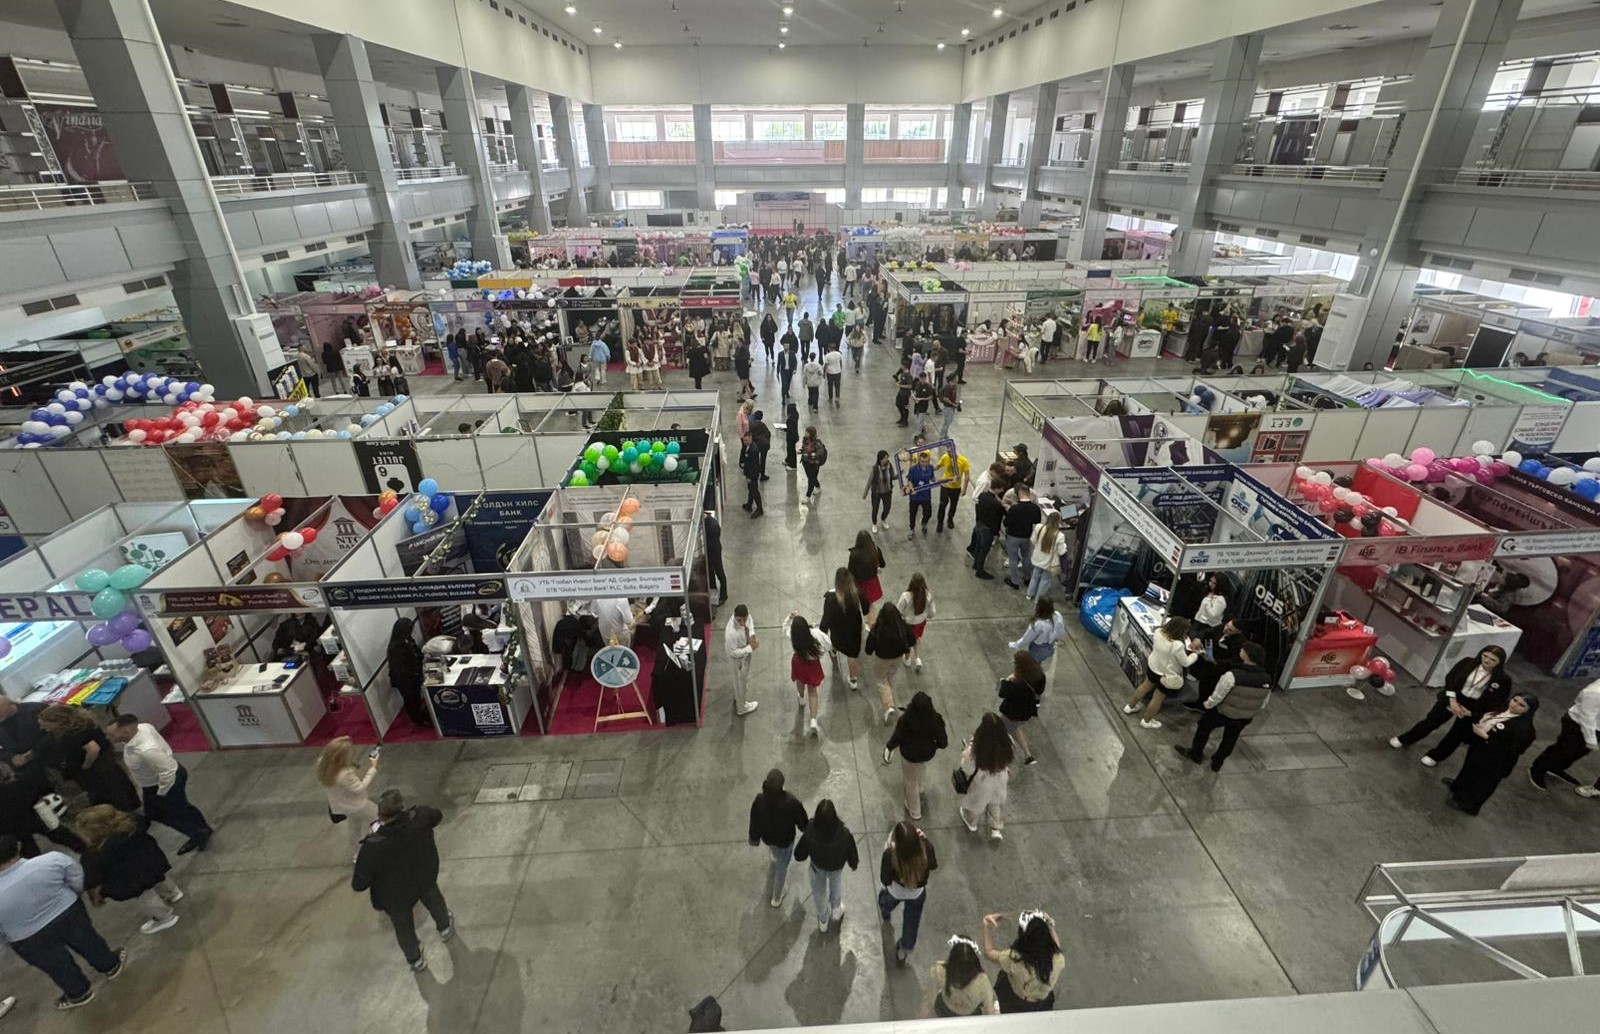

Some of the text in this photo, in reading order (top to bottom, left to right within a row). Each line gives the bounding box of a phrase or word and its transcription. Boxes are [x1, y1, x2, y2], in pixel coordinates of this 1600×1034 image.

[620, 435, 688, 443] SUSTAINABLE
[372, 456, 404, 465] JULIET
[1410, 544, 1451, 554] Finance
[1457, 542, 1483, 552] Bank
[1255, 584, 1284, 615] ОББ
